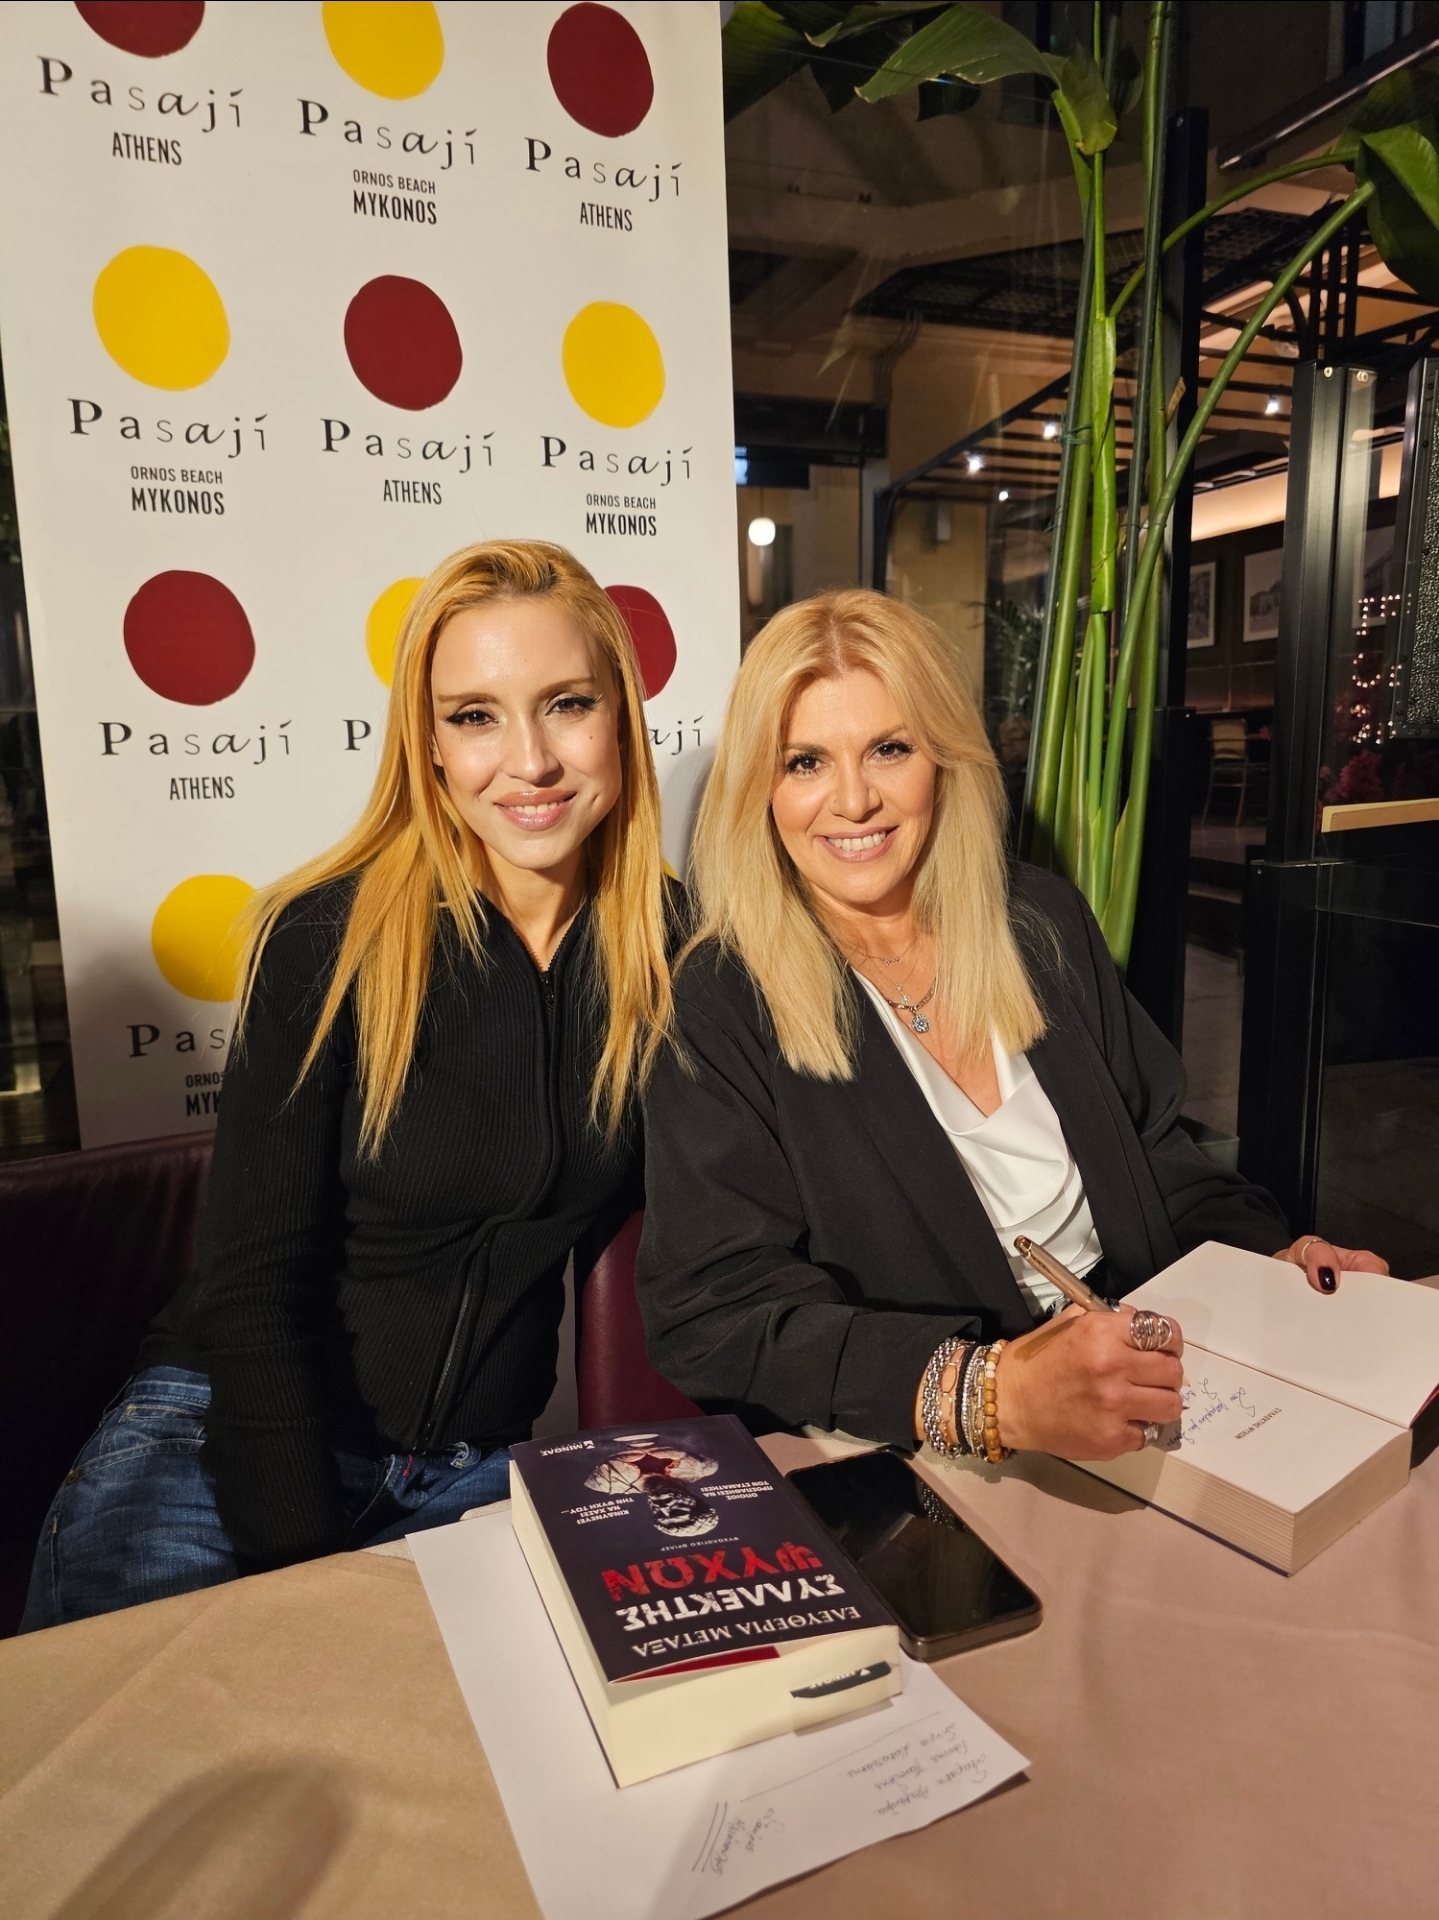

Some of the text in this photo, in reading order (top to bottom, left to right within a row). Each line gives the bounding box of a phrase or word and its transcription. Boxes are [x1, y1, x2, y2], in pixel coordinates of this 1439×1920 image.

[111, 131, 182, 166] ATHENS
[352, 169, 436, 194] ORNOS BEACH
[352, 190, 438, 225] MYKONOS
[579, 201, 633, 232] ATHENS
[130, 465, 223, 485] ORNOS BEACH
[131, 486, 226, 516] MYKONOS
[383, 478, 443, 506] ATHENS
[585, 493, 656, 510] ORNOS BEACH
[585, 511, 657, 536] MYKONOS
[169, 775, 235, 801] ATHENS
[700, 1480, 770, 1493] ΤΟΝ ΣΤΑΜΑΤΗΣΕΙ
[717, 1485, 774, 1497] ΠΡΟΣΠΑΘΗΣΕΙ
[725, 1492, 759, 1501] ΟΠΟΙΟΣ
[576, 1509, 630, 1525] ΚΙΝΔΥΝΕΥΕΙ
[580, 1508, 606, 1518] ΧΑΣΕΙ
[589, 1500, 615, 1509] ΨΥΧΗ
[690, 1536, 740, 1547] ΨΥΧΟΛΟΓΙΚΟ
[601, 1541, 822, 1602] ΨΥΧΩΝ
[615, 1573, 846, 1632] ΣΥΛΛΕΚΤΗΣ
[631, 1605, 862, 1658] ΕΛΕΥΘΕΡΙΑ ΜΕΤΑΞΑ
